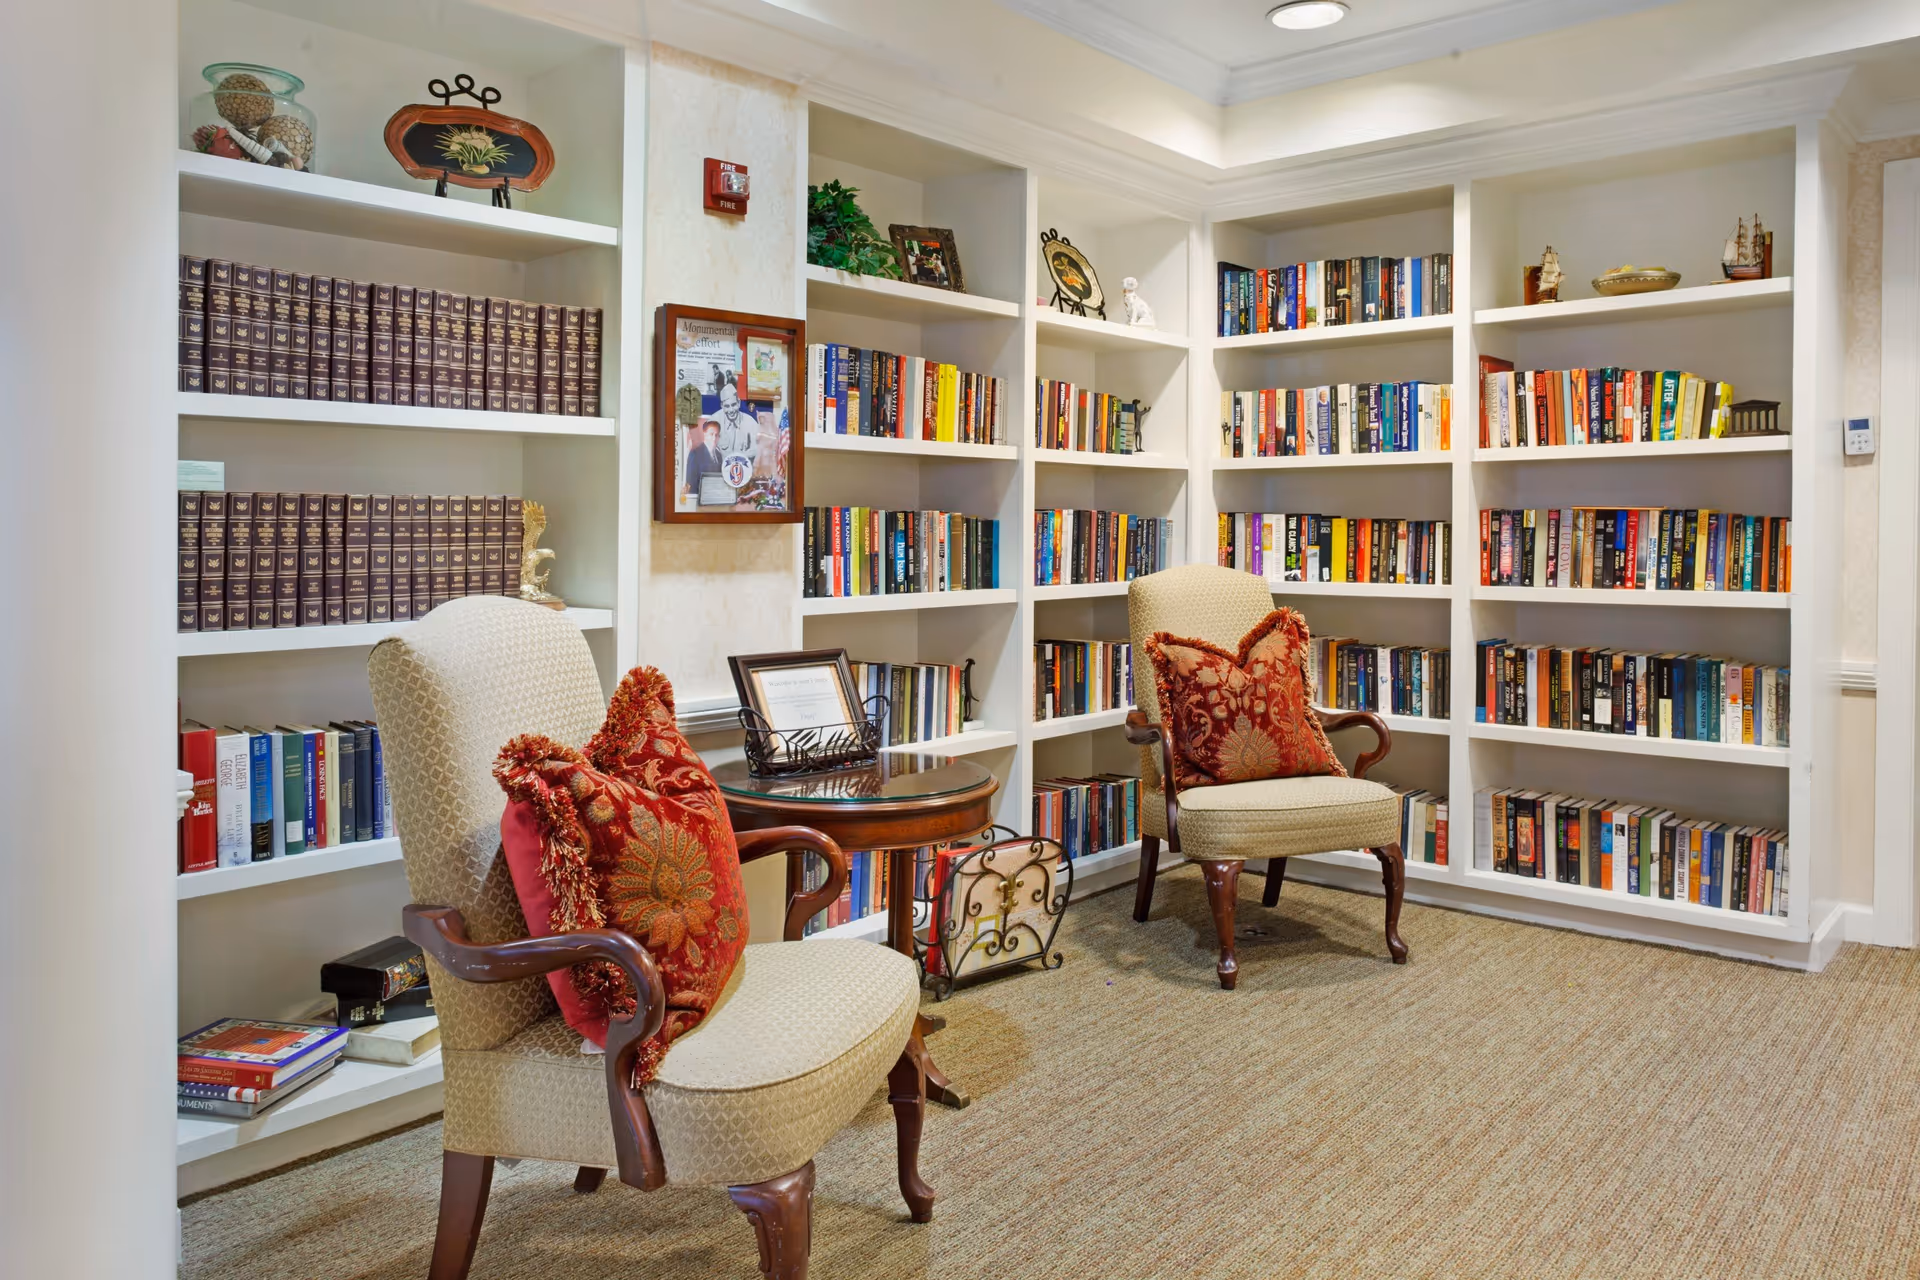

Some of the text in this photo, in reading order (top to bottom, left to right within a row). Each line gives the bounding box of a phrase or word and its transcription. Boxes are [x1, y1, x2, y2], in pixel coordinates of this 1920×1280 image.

[720, 162, 736, 172] FIRE
[720, 200, 736, 210] FIRE
[682, 321, 736, 336] Monumental
[696, 337, 720, 348] effort
[1664, 378, 1674, 402] AFTER
[1370, 386, 1378, 422] Harvard Yard
[1590, 402, 1600, 419] DeMille
[1288, 517, 1296, 553] TOM CLANCY
[1661, 531, 1670, 556] BALDACCI
[1560, 523, 1572, 574] TUROW
[220, 760, 233, 788] GEORGE
[235, 754, 248, 790] ELIZABETH
[1495, 798, 1503, 824] DAN BROWN
[226, 828, 235, 842] LIE
[234, 804, 243, 848] BELIEVING
